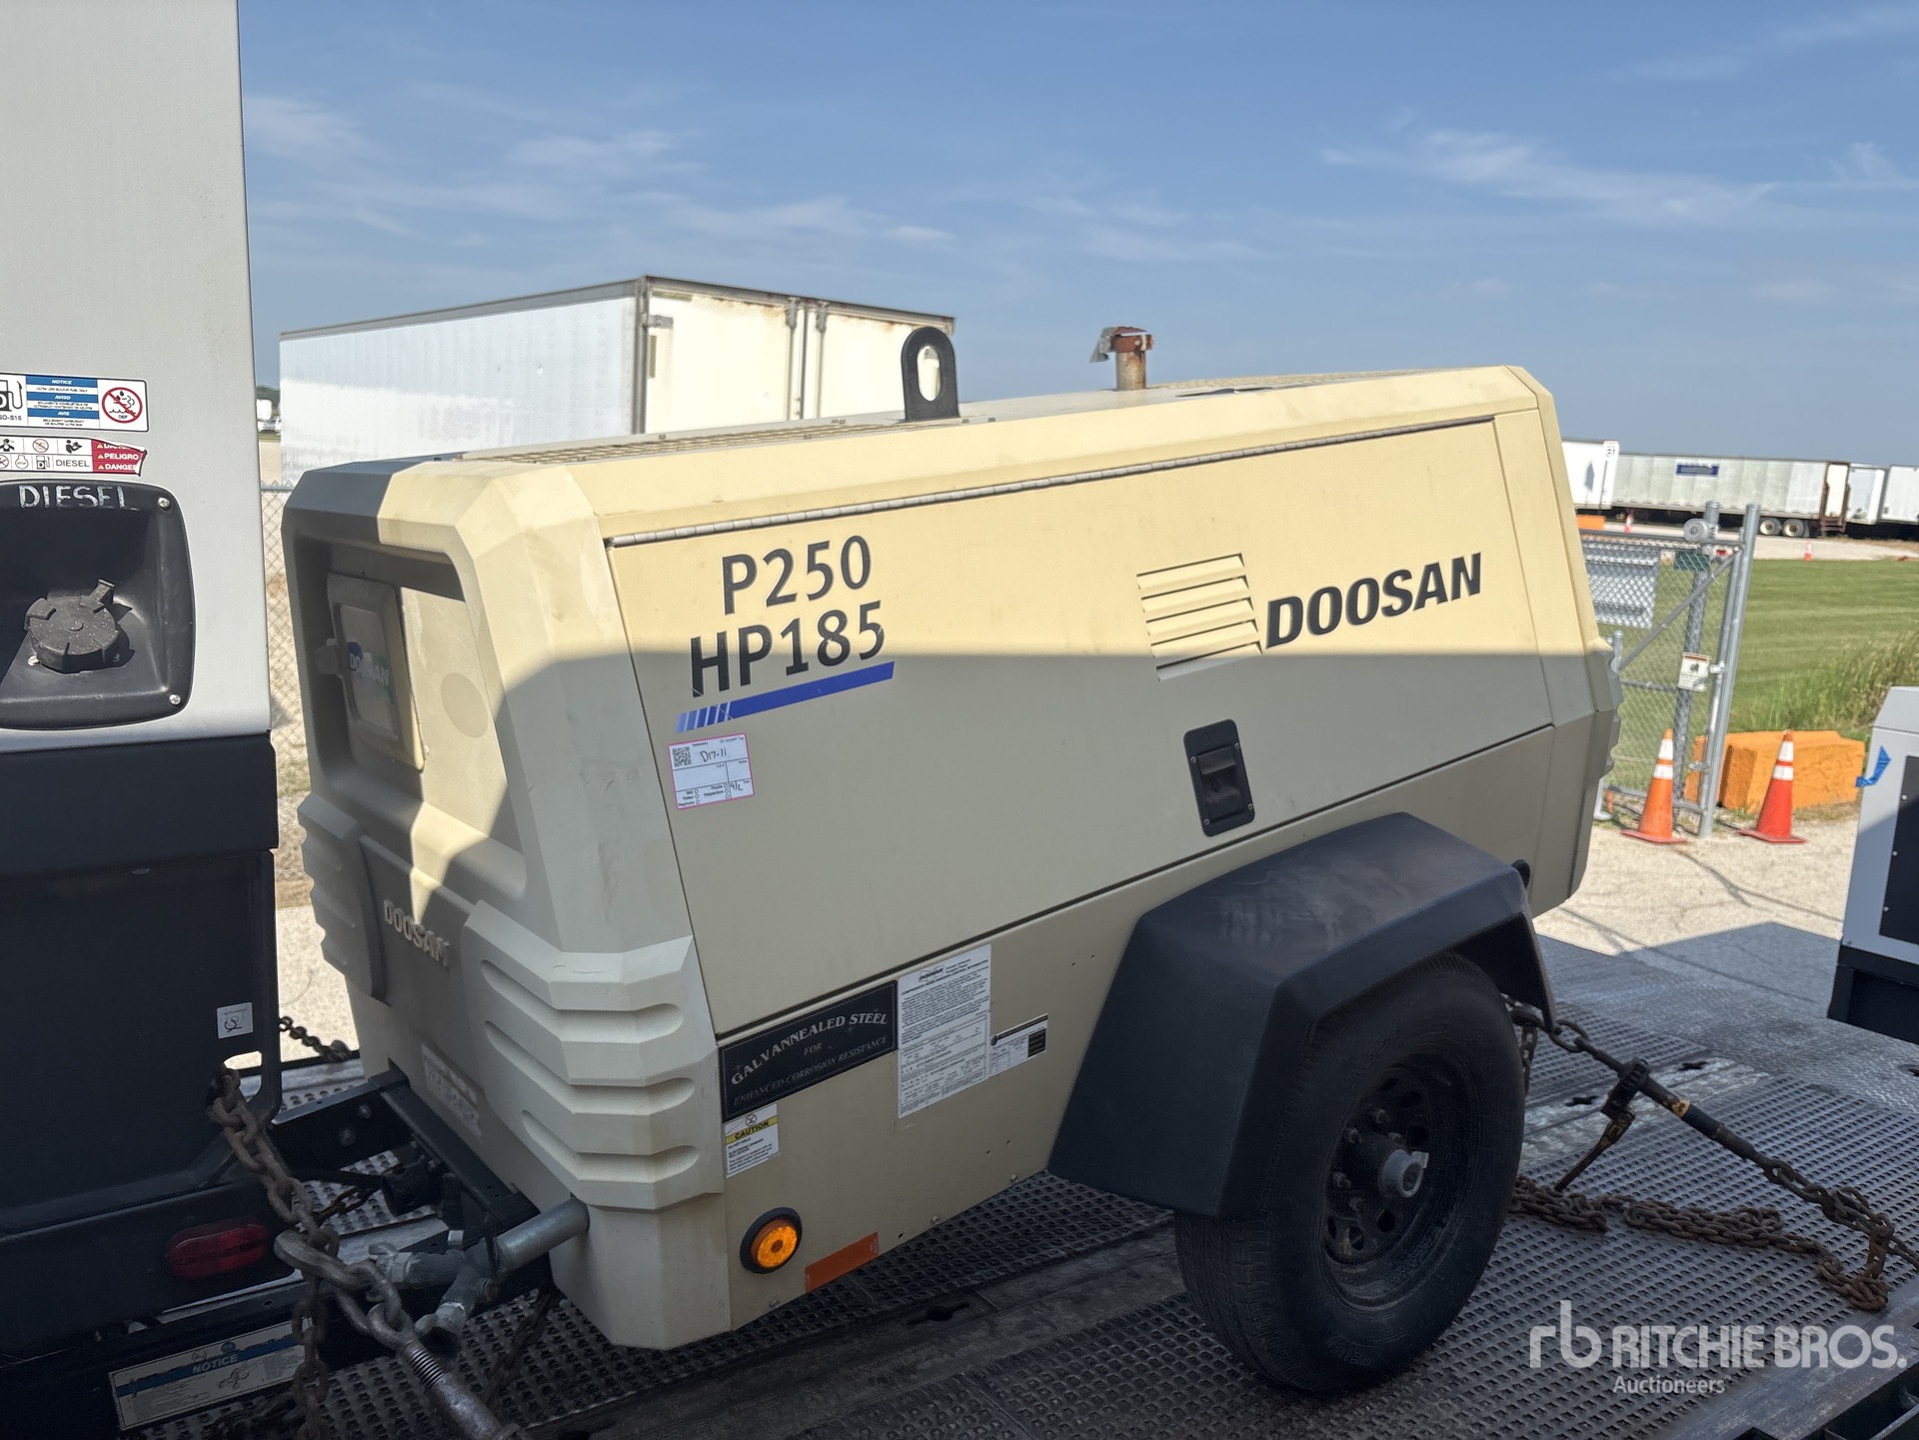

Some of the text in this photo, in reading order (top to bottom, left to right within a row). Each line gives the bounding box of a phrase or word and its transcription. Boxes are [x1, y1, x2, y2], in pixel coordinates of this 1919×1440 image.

[55, 459, 90, 468] DIESEL
[104, 453, 139, 461] PELIGRO
[19, 485, 140, 512] DIESEL
[722, 535, 871, 616] P250
[1265, 552, 1481, 650] DOOSAN
[691, 600, 885, 698] HP185
[731, 1012, 888, 1085] GALVANNEALED STEEL
[803, 1042, 823, 1056] FOR
[734, 1120, 769, 1140] CAUTION
[191, 1352, 239, 1374] NOTICE
